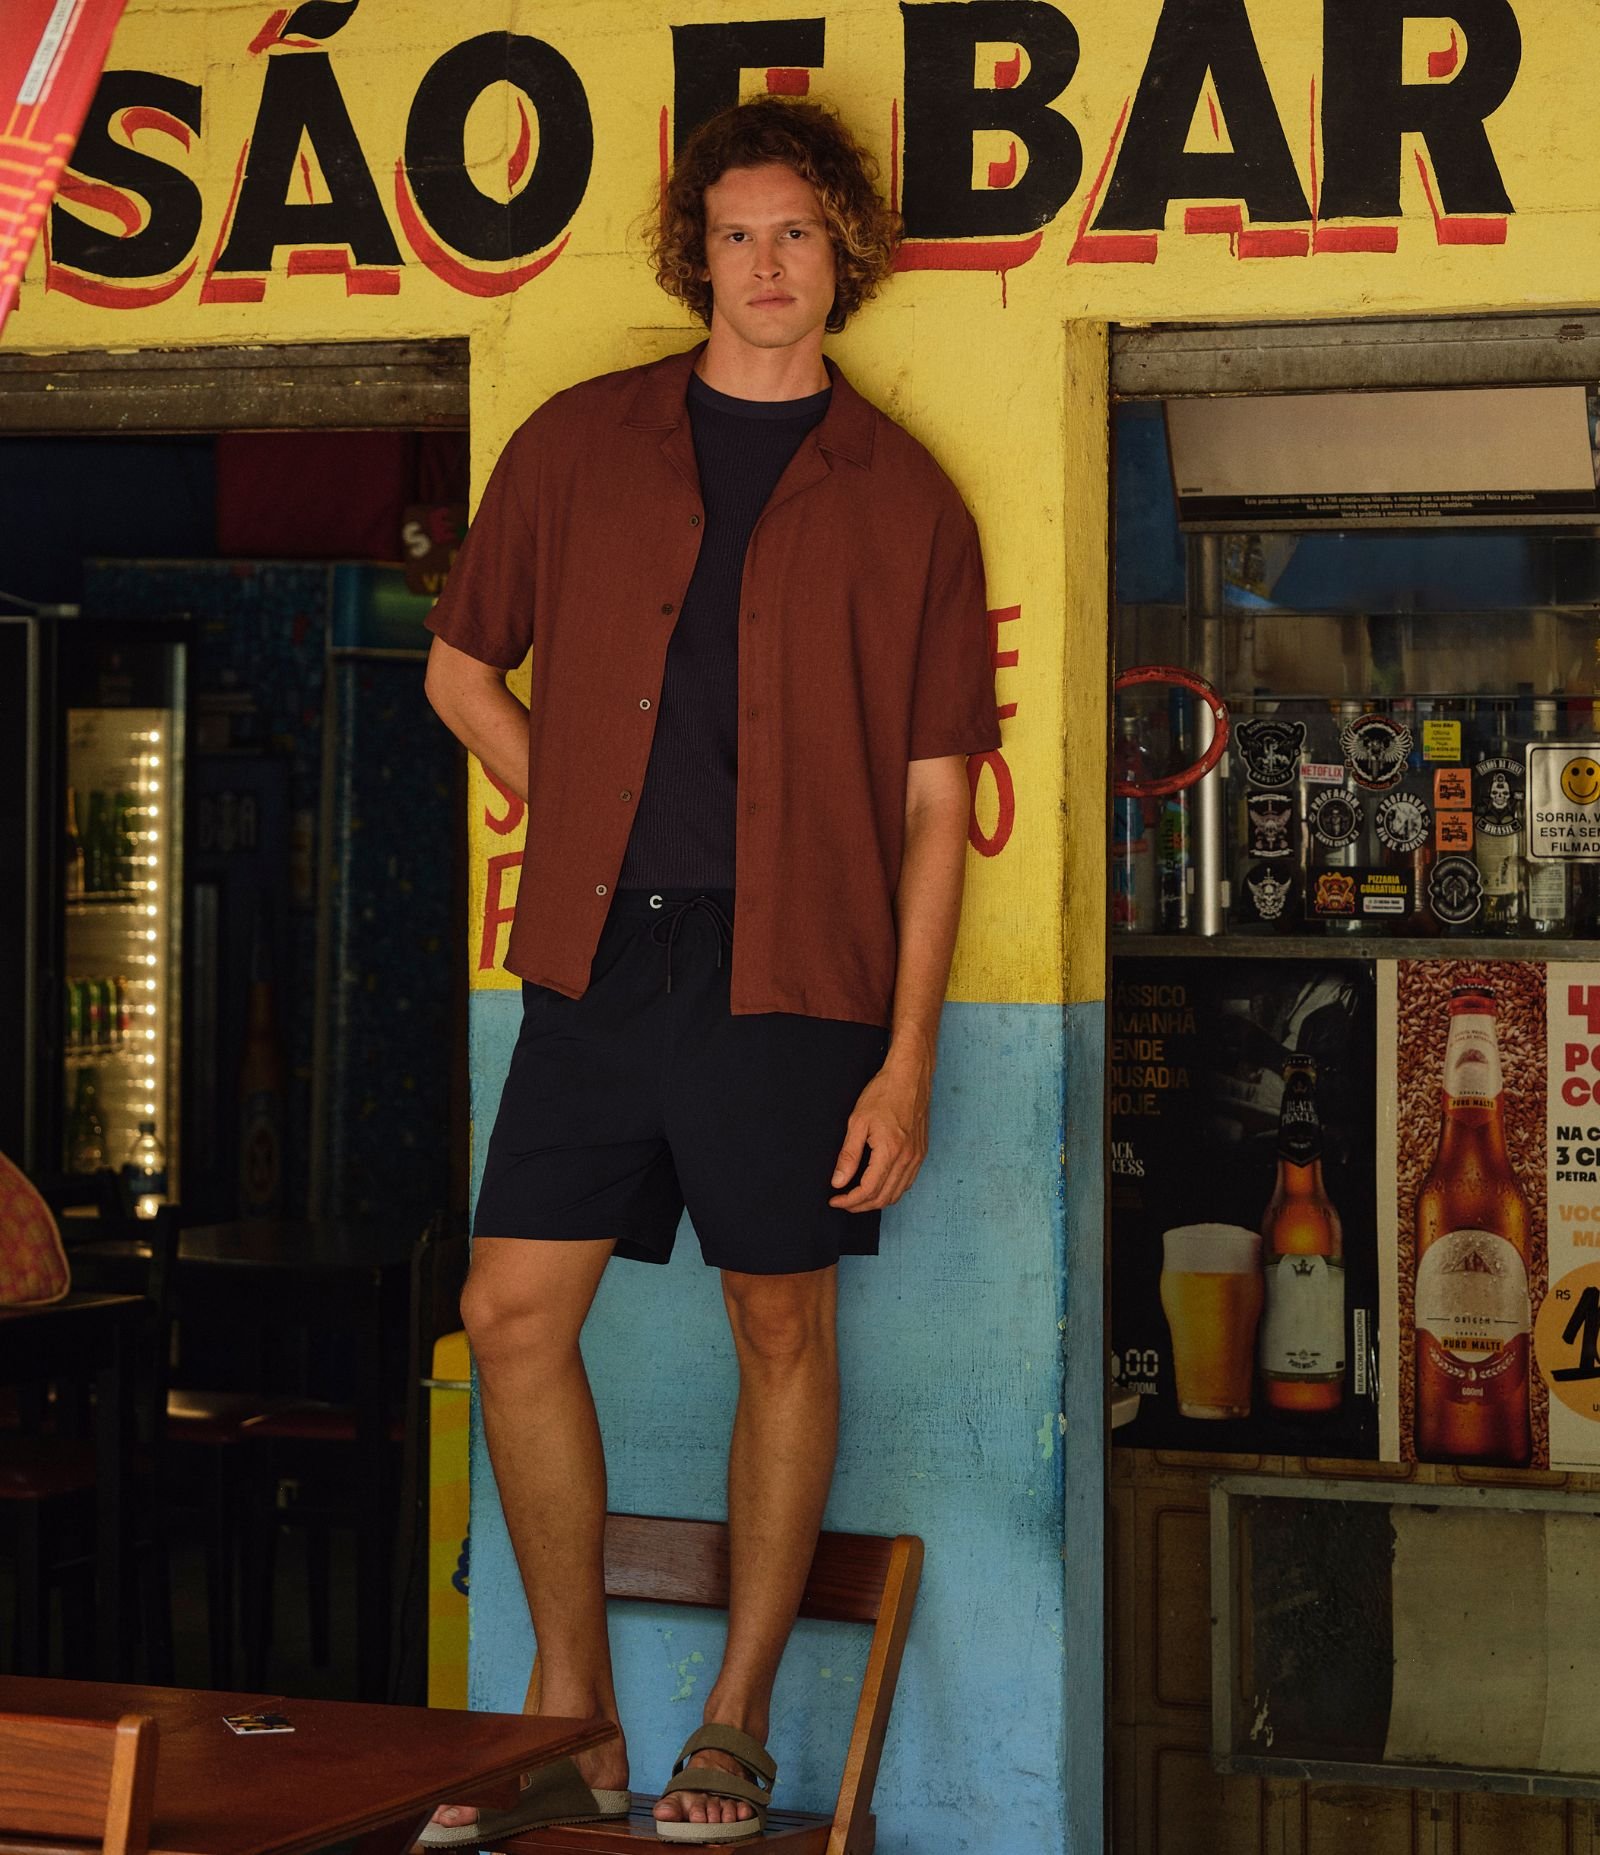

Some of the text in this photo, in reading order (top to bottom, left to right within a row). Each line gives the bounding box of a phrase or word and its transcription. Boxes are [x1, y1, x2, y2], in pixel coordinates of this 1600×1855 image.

[900, 0, 1523, 240] BAR
[1301, 764, 1343, 778] NETOFLIX
[1311, 788, 1360, 811] PROFANUM
[1380, 792, 1428, 813] PROFANUM
[1536, 812, 1591, 825] SORRIA,
[1540, 824, 1575, 837] ESTÁ
[1112, 1039, 1165, 1062] ENDE
[1556, 1126, 1583, 1141] NA
[1556, 1146, 1570, 1166] 3
[1112, 1158, 1145, 1177] CESS
[1556, 1171, 1597, 1182] PETRA
[1443, 1339, 1501, 1350] PURO MALTE
